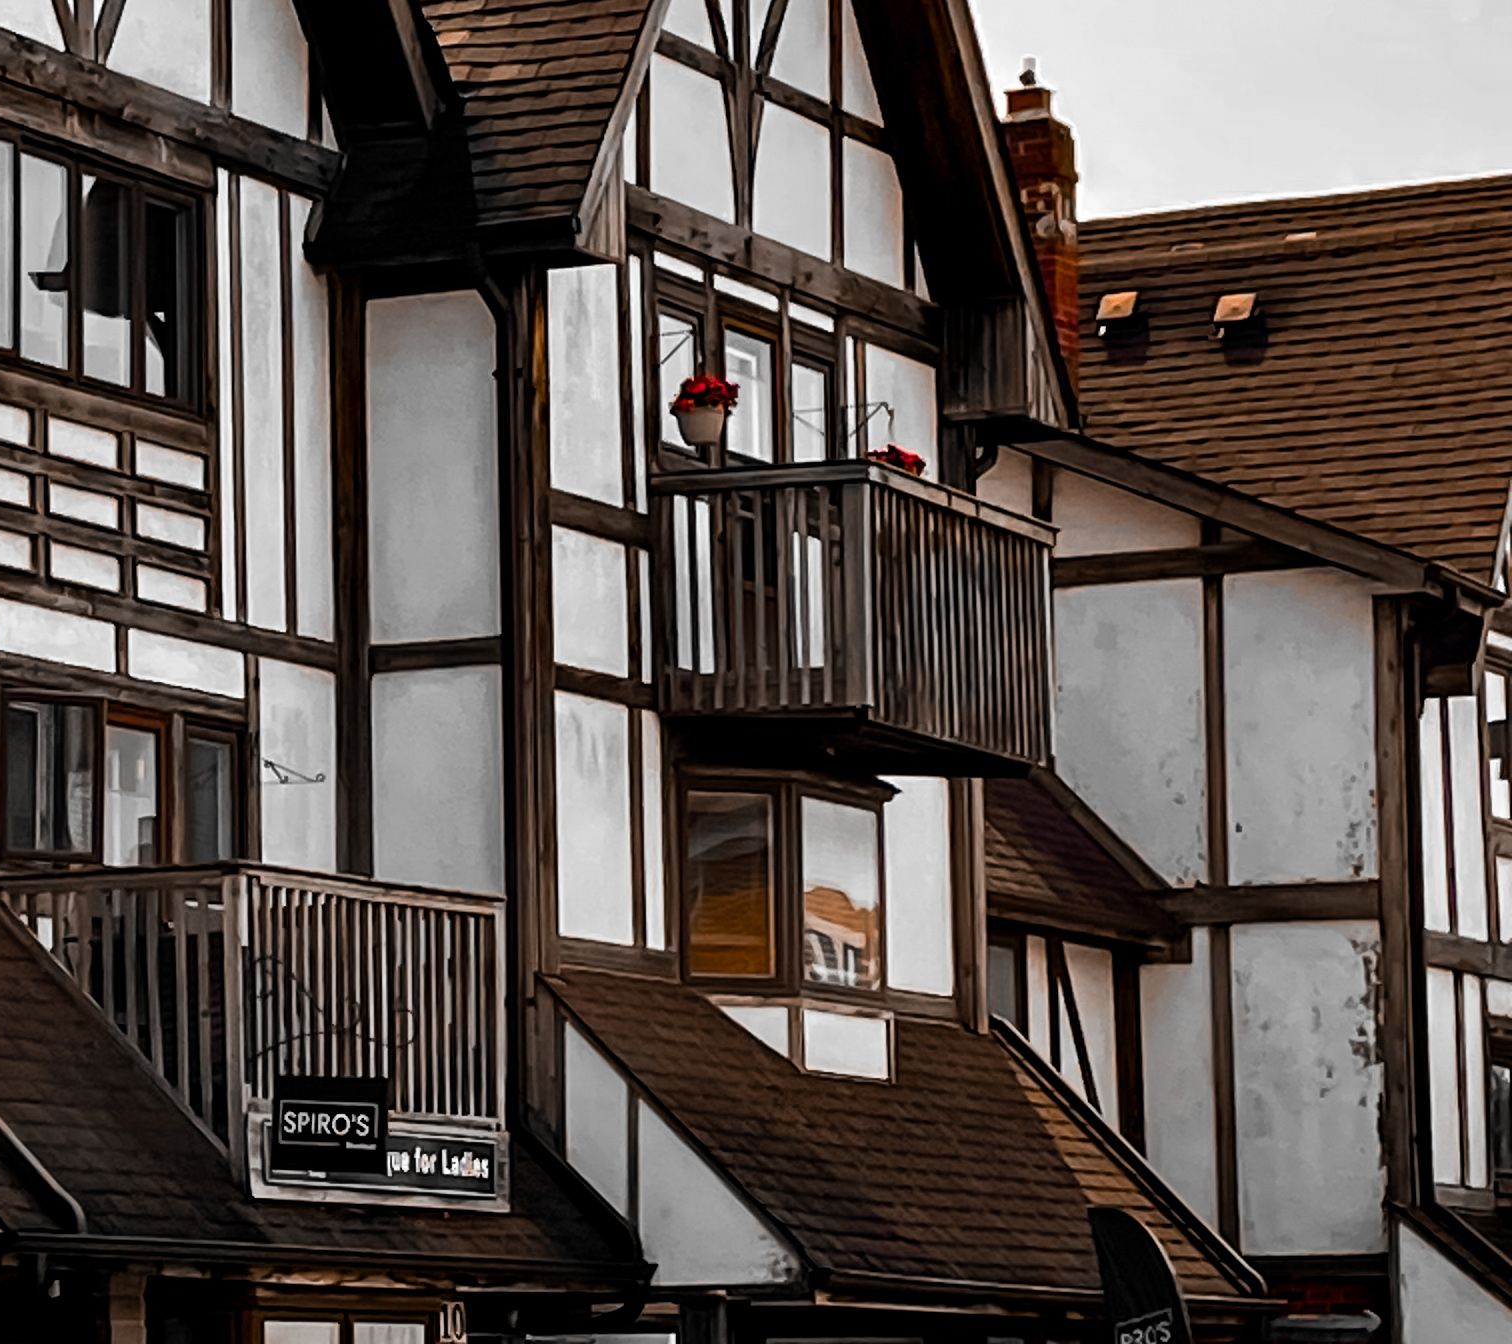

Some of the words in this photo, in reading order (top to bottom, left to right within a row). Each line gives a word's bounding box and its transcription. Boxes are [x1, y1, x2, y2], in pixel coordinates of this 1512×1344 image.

[283, 1111, 370, 1137] SPIRO'S
[414, 1146, 437, 1175] for
[441, 1302, 464, 1341] 10
